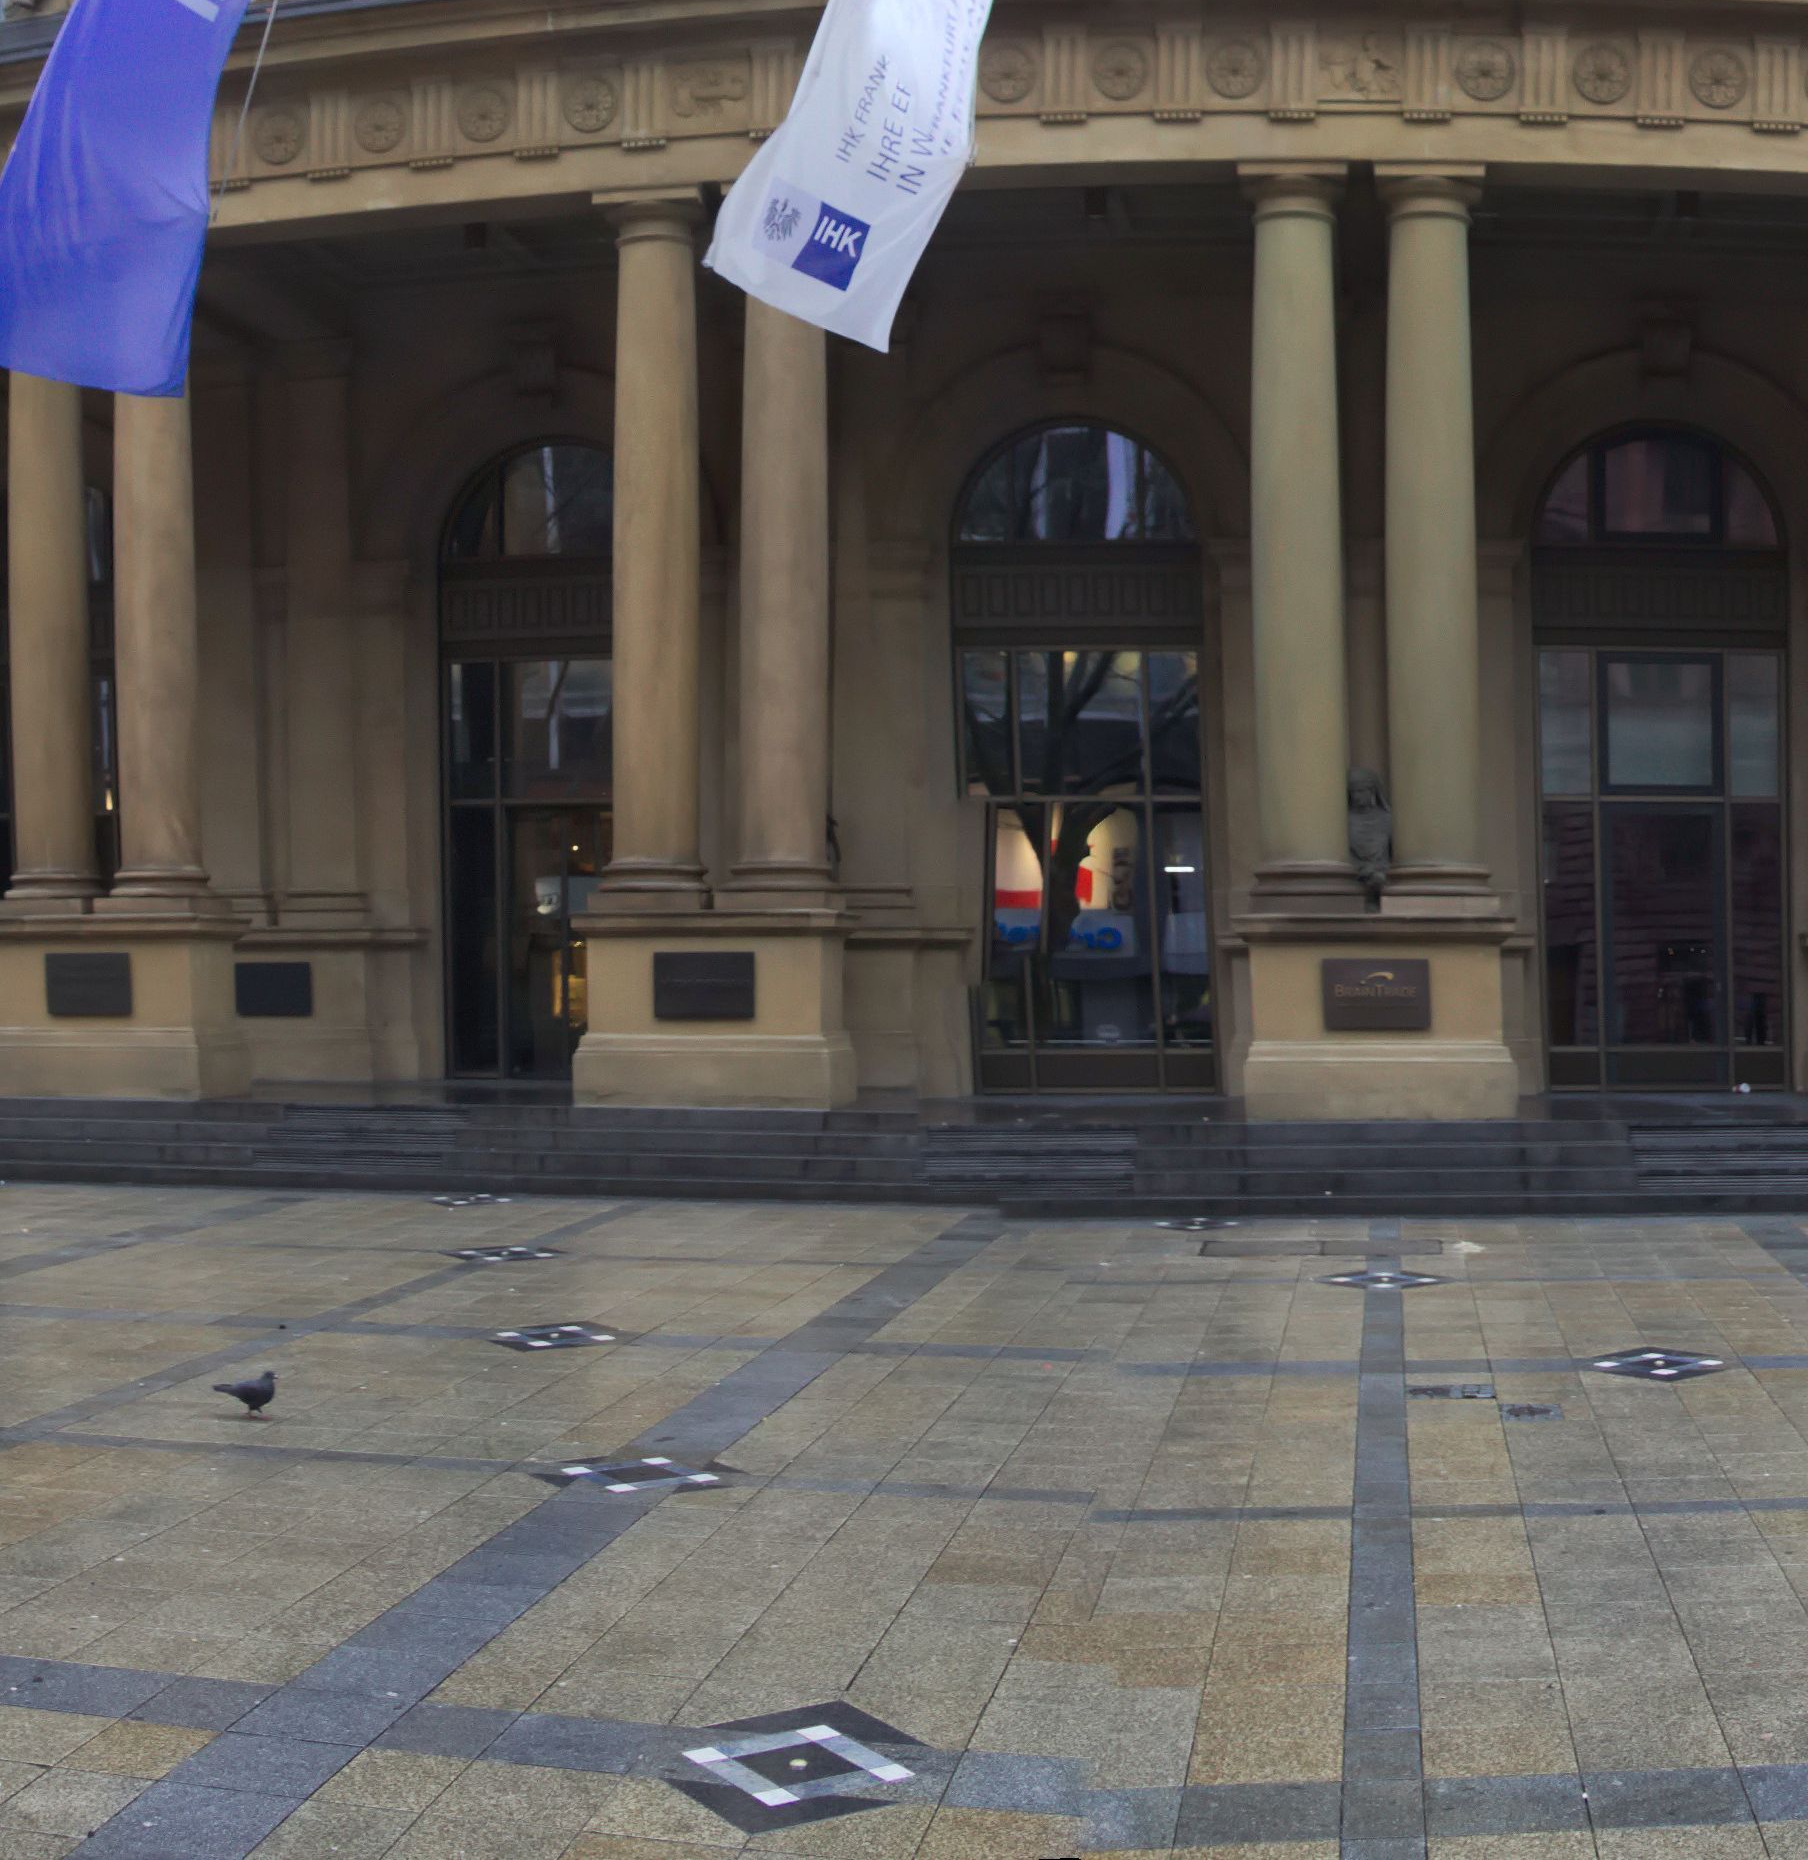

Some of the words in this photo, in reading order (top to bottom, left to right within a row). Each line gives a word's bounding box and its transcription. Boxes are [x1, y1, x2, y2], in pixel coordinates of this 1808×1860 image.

[835, 126, 865, 163] IHK
[866, 118, 904, 182] IHRE
[896, 165, 925, 195] IN
[814, 216, 862, 258] IHK
